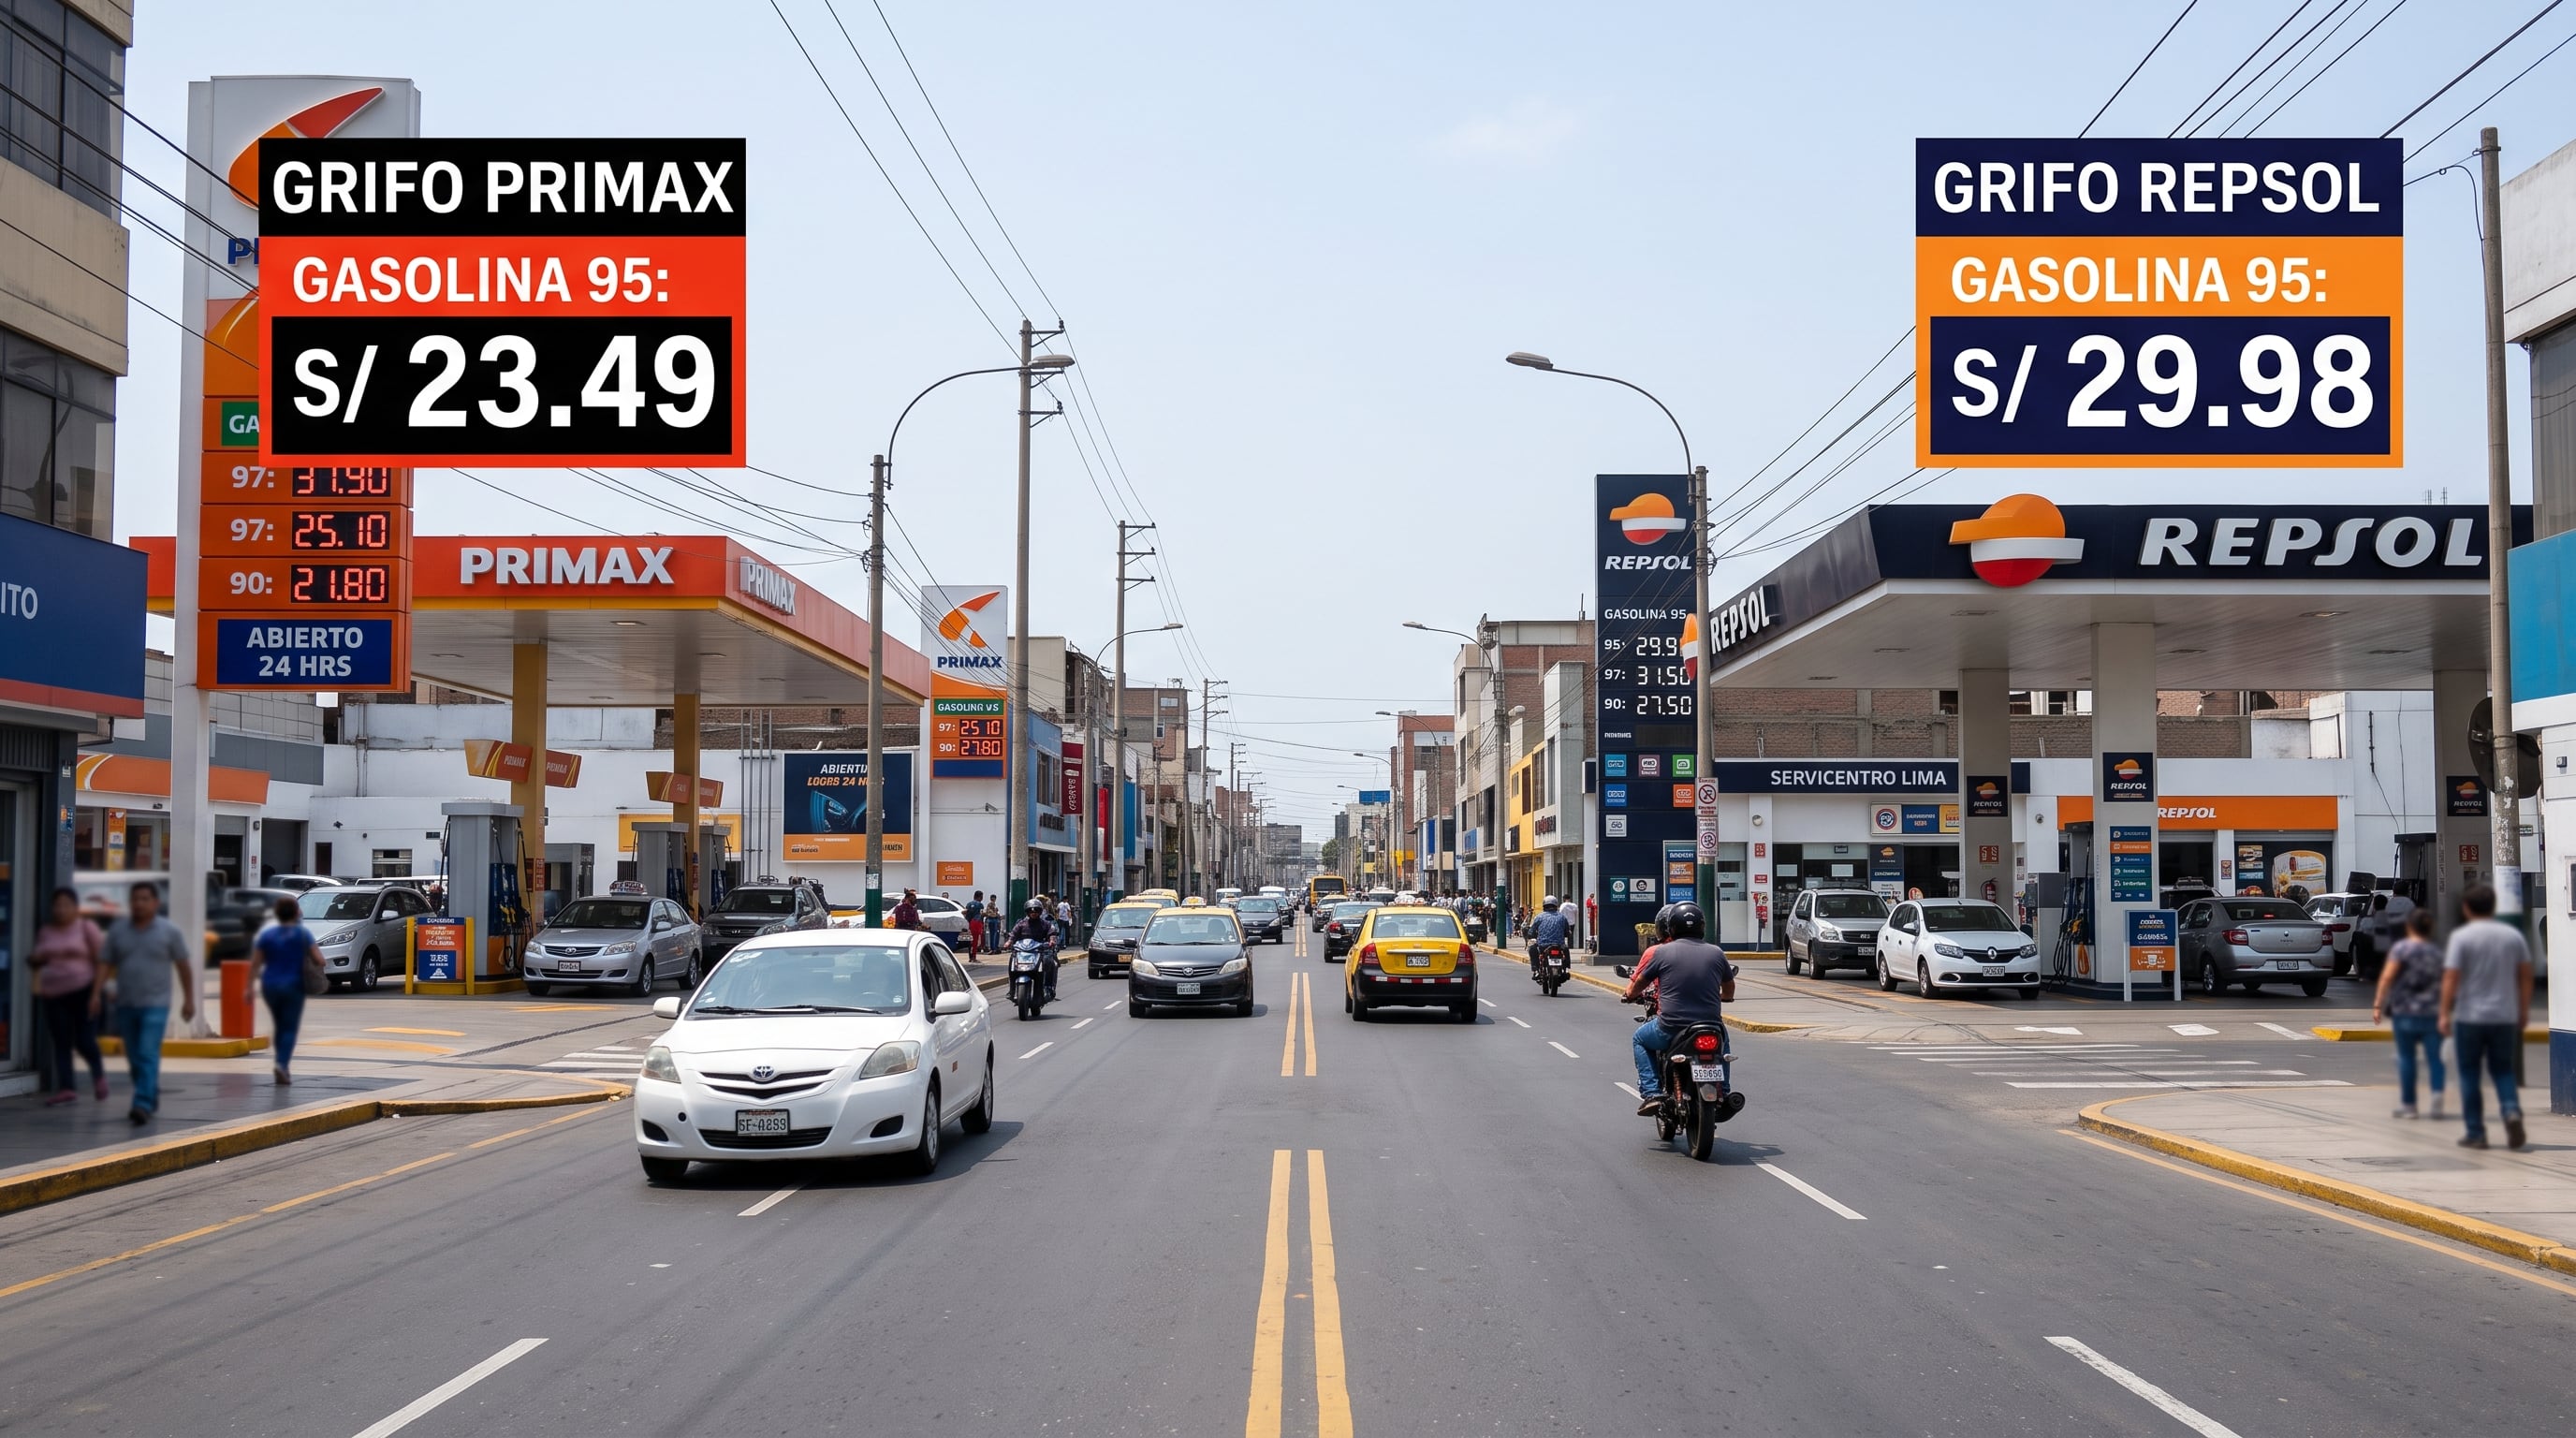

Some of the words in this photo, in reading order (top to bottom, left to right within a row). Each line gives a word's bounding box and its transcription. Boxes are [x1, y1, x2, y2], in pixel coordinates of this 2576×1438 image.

[231, 465, 274, 489] 97:
[230, 518, 273, 541] 97:
[295, 514, 387, 548] 25.10
[2138, 516, 2482, 568] REPSOL
[460, 546, 675, 586] PRIMAX
[1604, 555, 1692, 571] REPSOL
[229, 571, 273, 594] 90:
[294, 567, 386, 601] 21.80
[740, 556, 797, 616] PRIMAX
[1604, 609, 1668, 620] GASOLINA
[1710, 585, 1770, 655] REPSOL
[246, 626, 364, 649] ABIERTO
[258, 655, 292, 677] 24
[300, 655, 353, 677] HRS
[937, 656, 1003, 668] PRIMAX
[1604, 669, 1626, 681] 97:
[1604, 698, 1626, 710] 90:
[1636, 696, 1692, 715] 27.50
[939, 723, 956, 732] 97:
[939, 743, 956, 752] 90:
[1770, 770, 1897, 785] SERVICENTRO
[1901, 770, 1947, 785] LIMA
[2157, 807, 2217, 819] REPSOL
